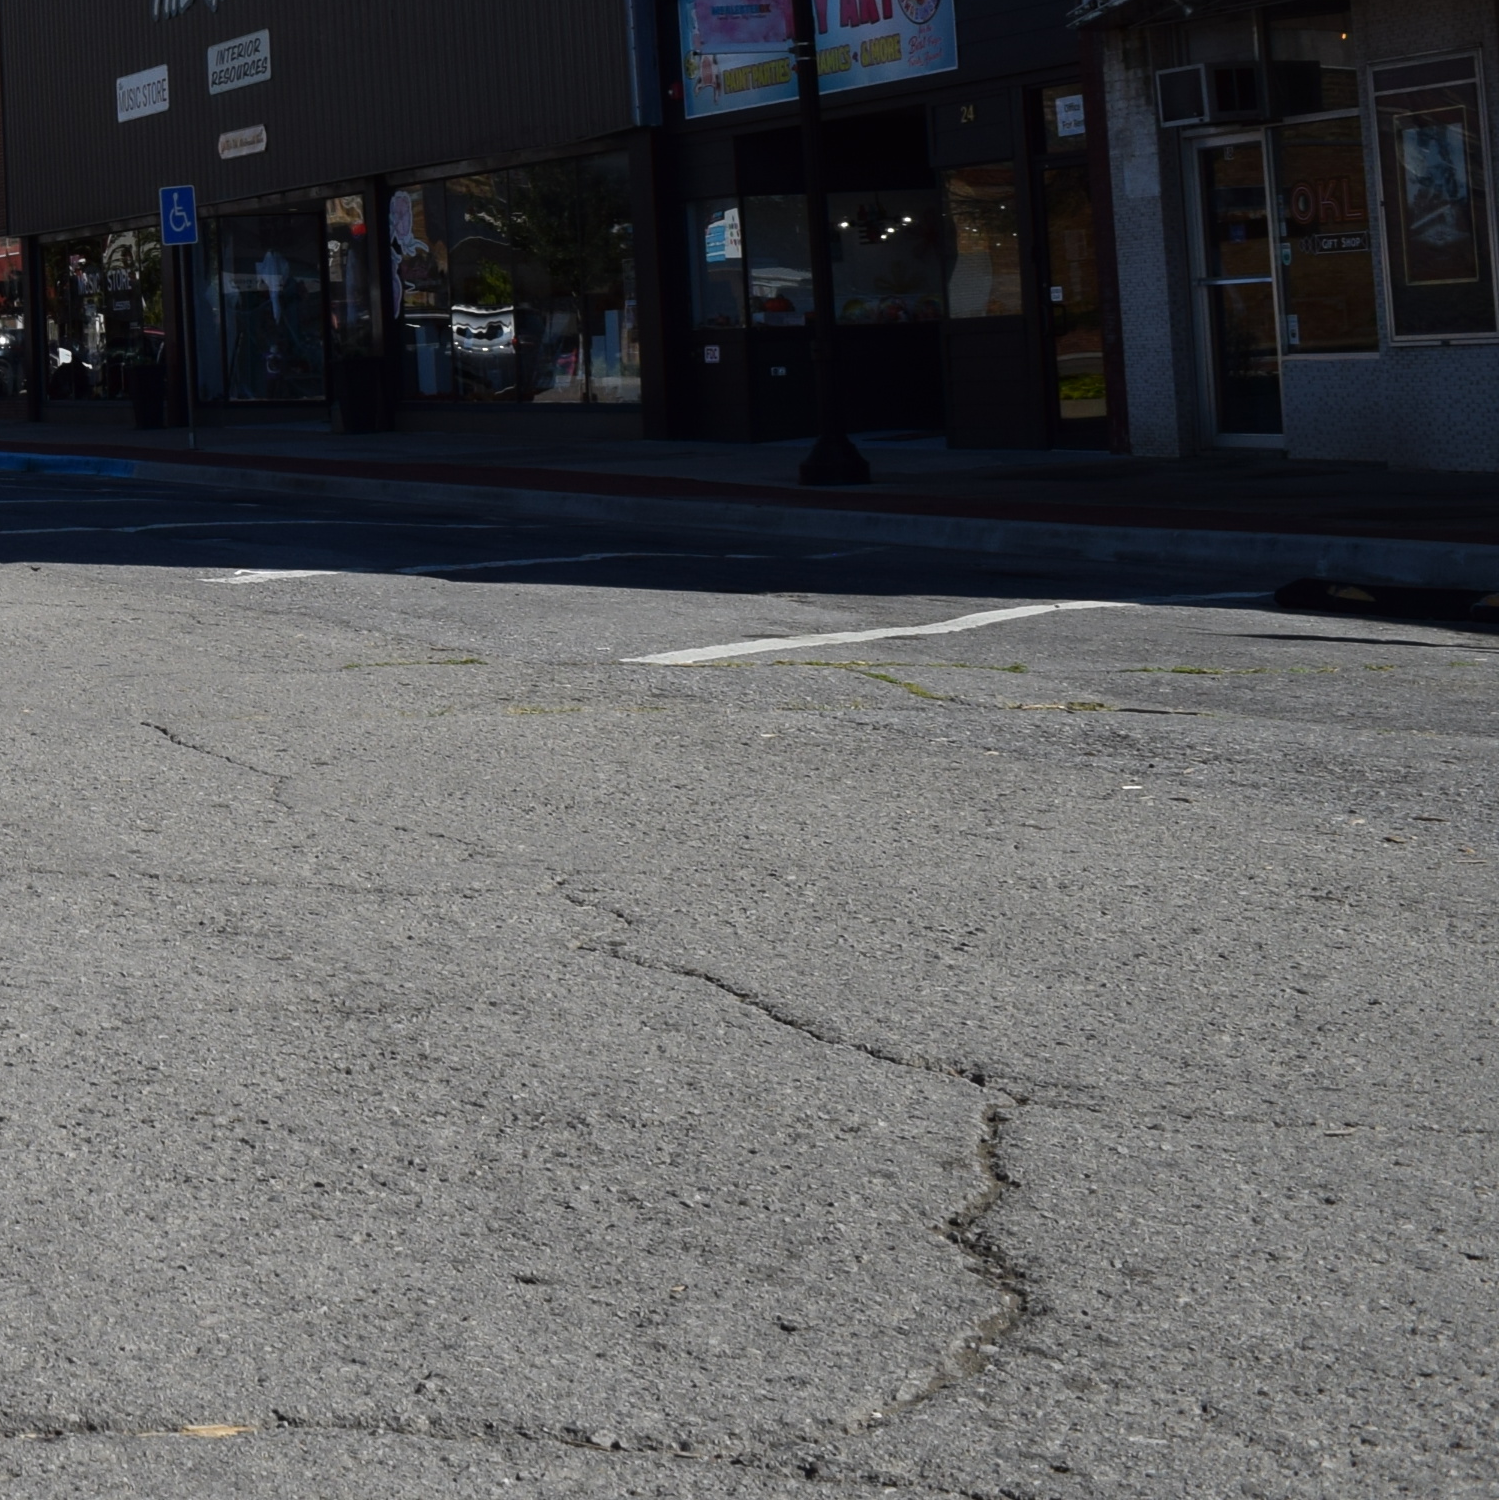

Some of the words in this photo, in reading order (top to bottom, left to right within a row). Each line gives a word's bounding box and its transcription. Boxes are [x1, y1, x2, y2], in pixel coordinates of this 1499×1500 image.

[216, 38, 260, 66] INTERIOR
[723, 66, 752, 94] PAINT
[752, 57, 790, 89] PARTIES
[871, 33, 901, 64] MORE
[211, 57, 267, 88] RESOURCES
[118, 87, 141, 113] MUSIC
[143, 79, 167, 107] STORE
[961, 104, 974, 123] 24
[1322, 238, 1338, 250] GIFT
[107, 268, 132, 292] STORE
